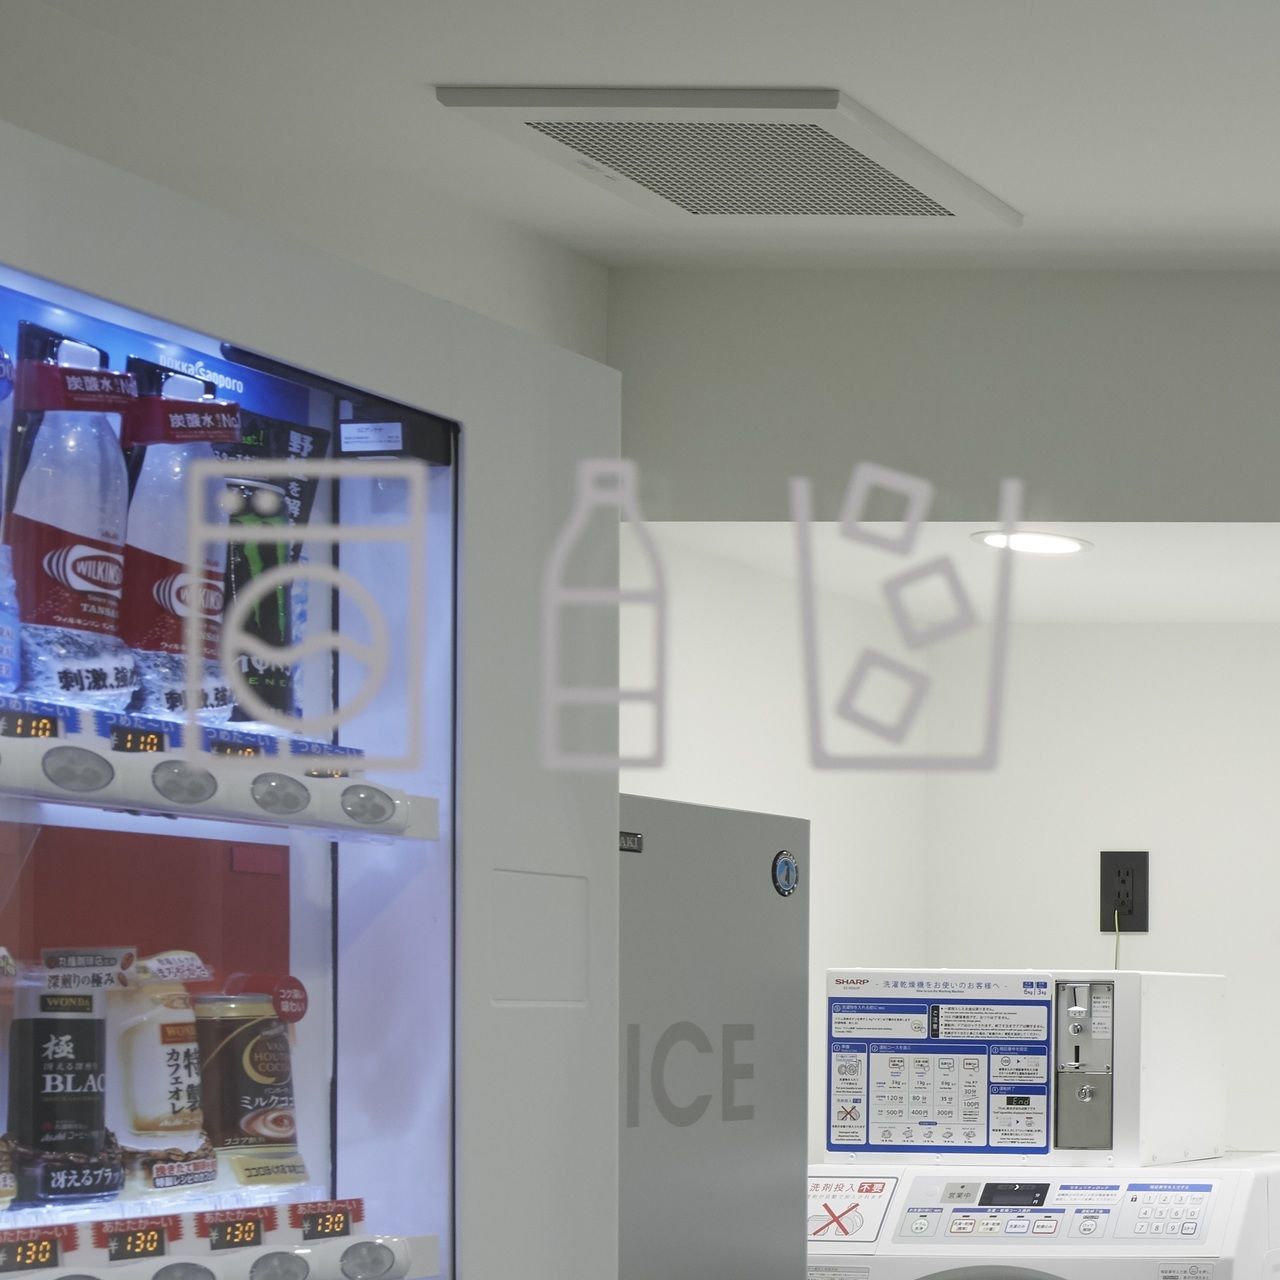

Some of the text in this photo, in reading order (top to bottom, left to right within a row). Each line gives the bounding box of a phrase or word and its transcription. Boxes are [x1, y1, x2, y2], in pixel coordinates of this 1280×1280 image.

[66, 375, 113, 393] 炭酸水
[169, 413, 215, 429] 炭酸水
[16, 718, 51, 738] 110
[126, 733, 158, 753] 110
[47, 971, 115, 990] 深煎りの極み
[834, 978, 869, 986] SHARP
[882, 980, 1000, 990] 洗濯乾燥機をお使いのお客様へ
[41, 1034, 75, 1060] 極
[166, 1048, 185, 1115] カフェオレ
[626, 1020, 755, 1128] ICE
[809, 1183, 885, 1193] 洗剤投入 不要
[225, 1222, 256, 1242] 130
[316, 1213, 345, 1233] 130
[126, 1230, 158, 1253] 130
[15, 1241, 51, 1266] 130
